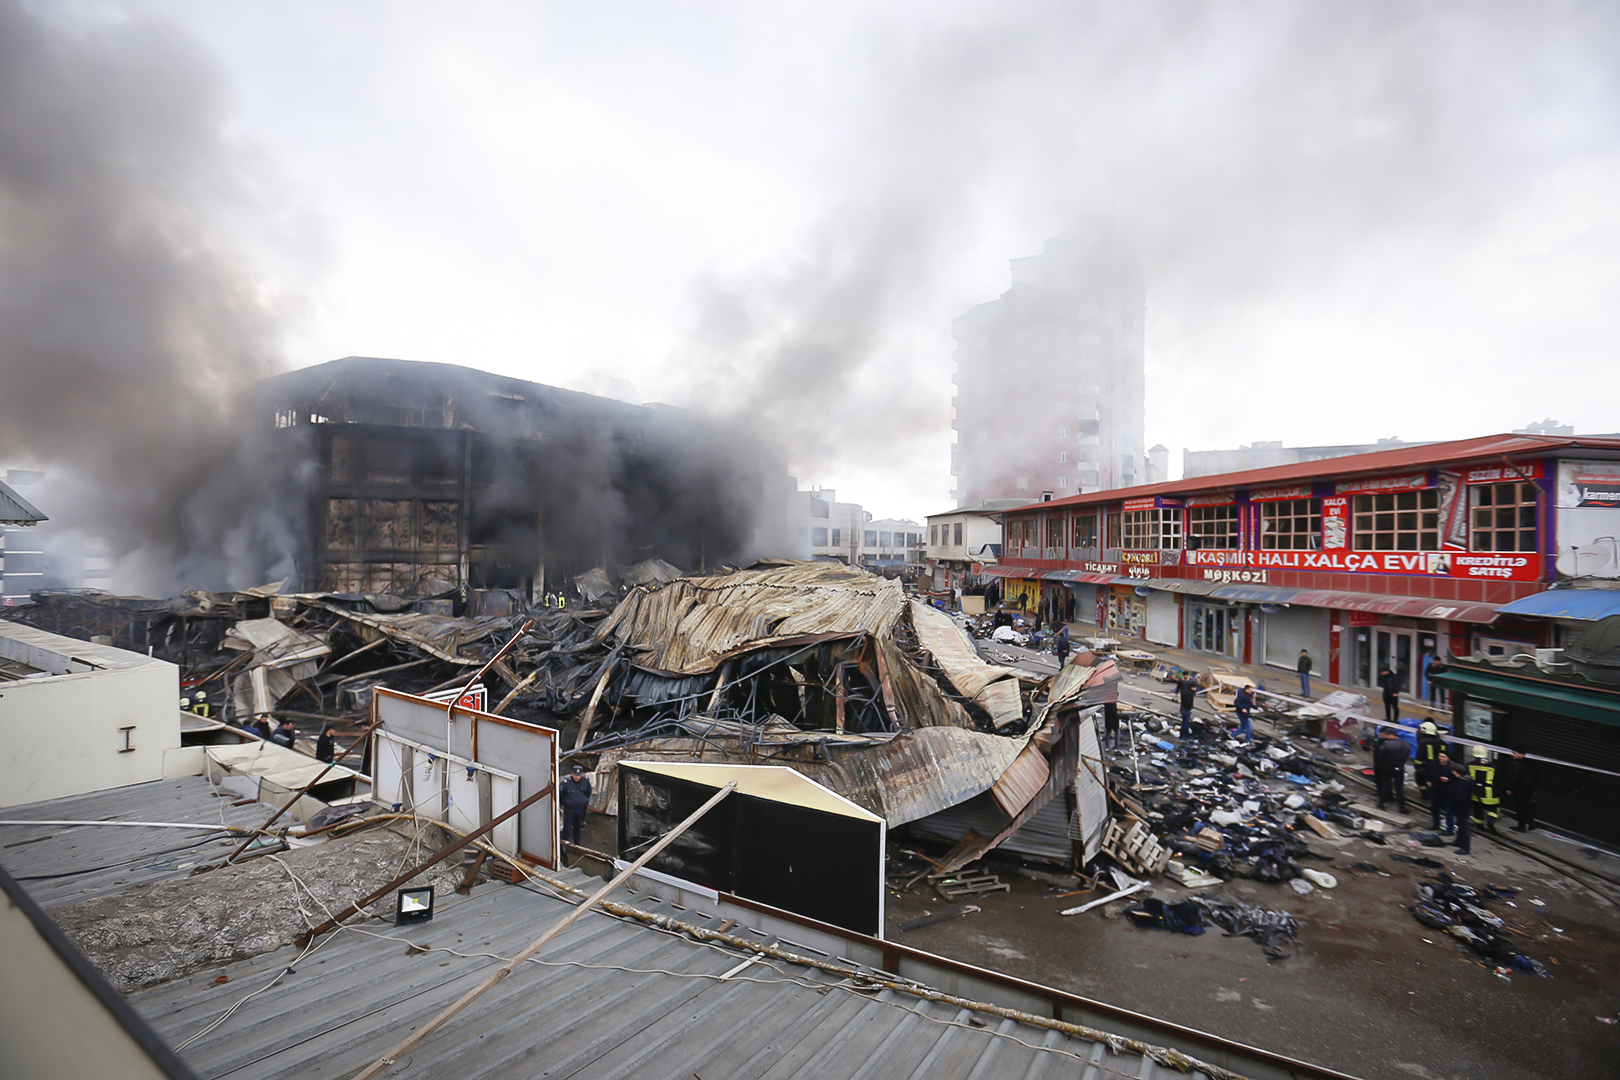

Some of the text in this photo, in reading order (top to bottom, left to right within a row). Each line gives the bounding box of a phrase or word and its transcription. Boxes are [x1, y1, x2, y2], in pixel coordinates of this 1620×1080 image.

[1323, 497, 1347, 507] XALÇA
[1197, 549, 1426, 572] KAŞMİR HALI XALÇA EVİ
[1468, 567, 1513, 579] SATIŞ
